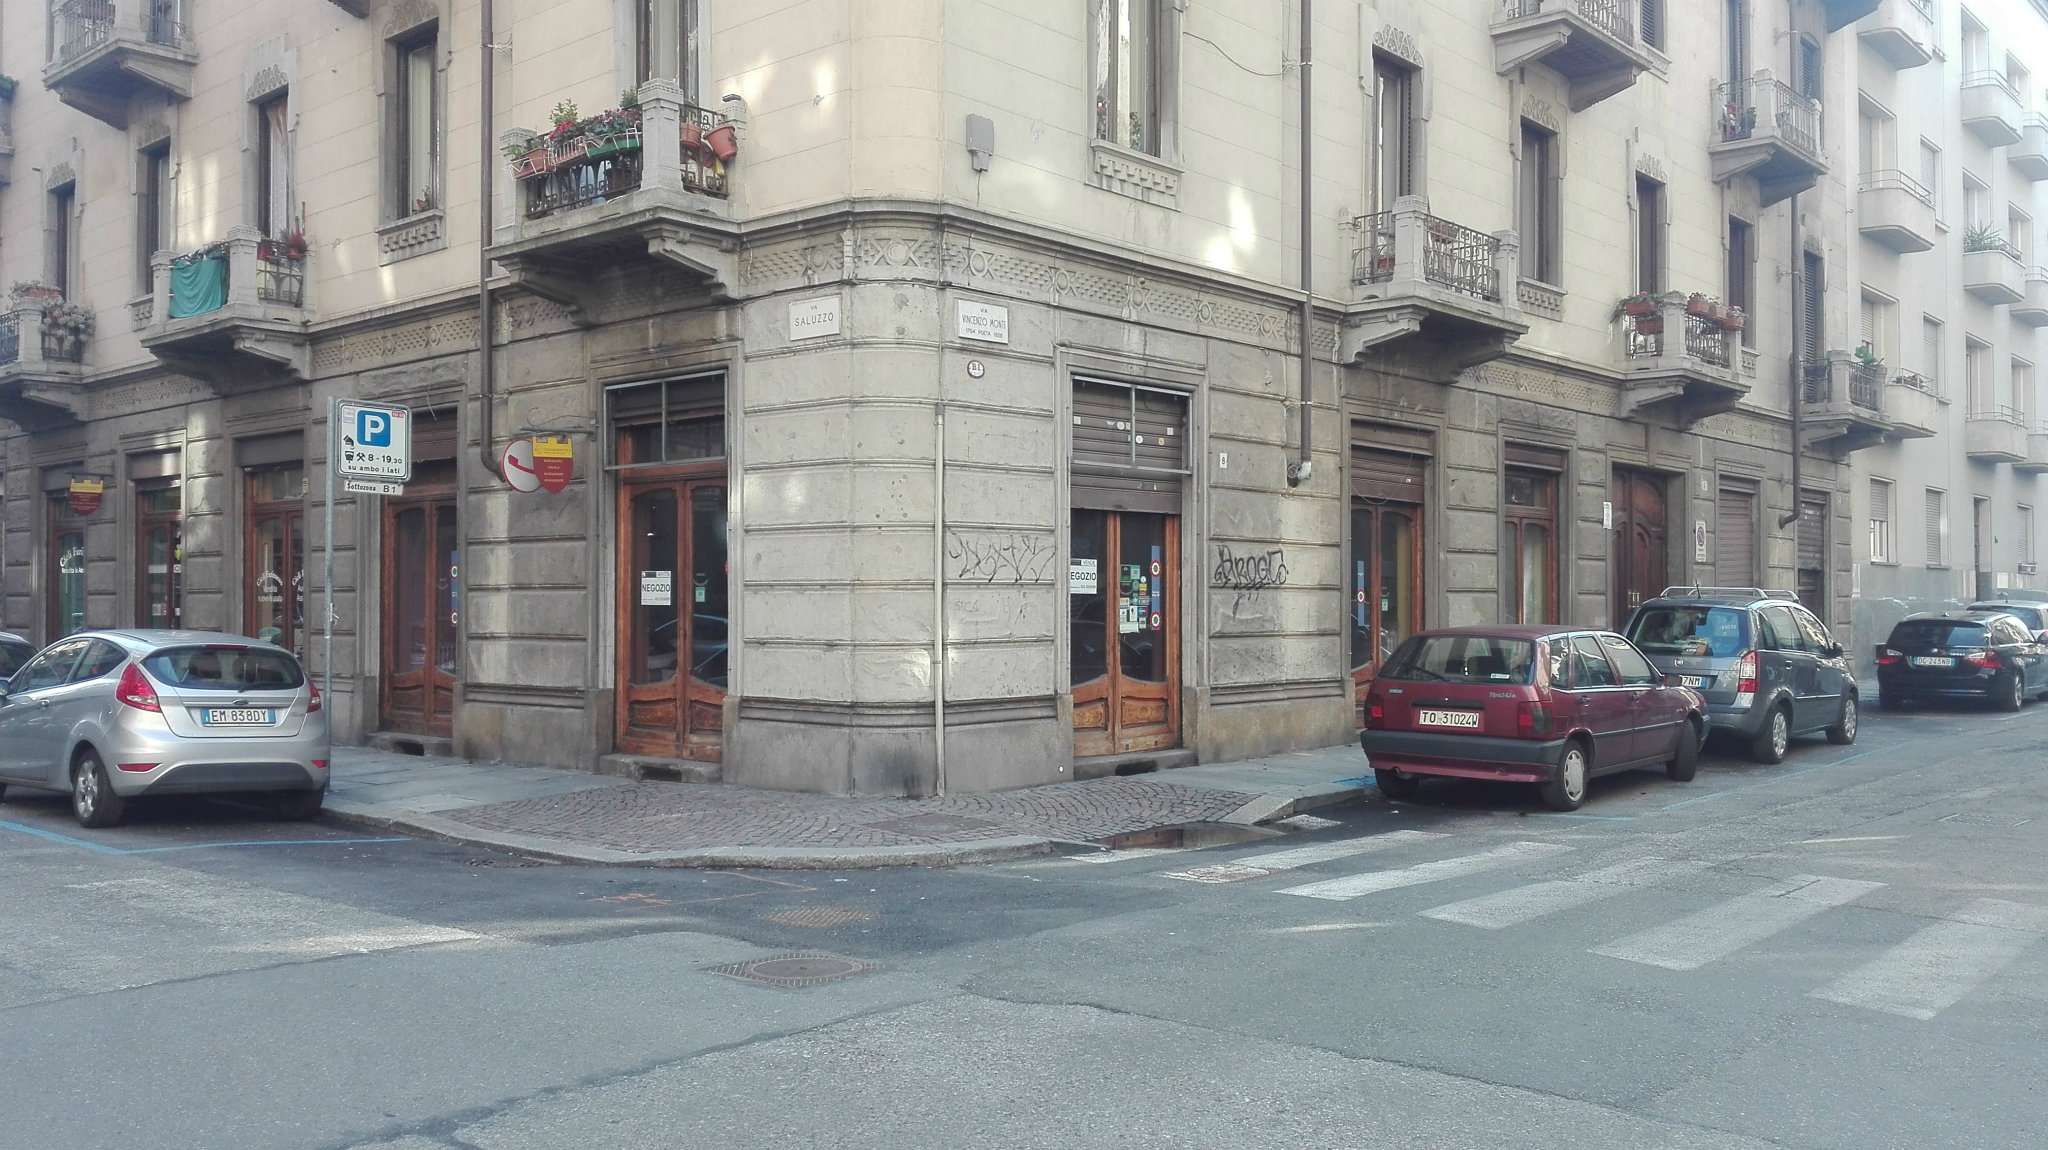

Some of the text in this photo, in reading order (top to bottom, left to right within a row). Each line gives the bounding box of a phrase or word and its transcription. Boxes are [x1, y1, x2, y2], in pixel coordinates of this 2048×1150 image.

[793, 312, 834, 327] SALUZZO
[962, 313, 988, 327] VINCENZO
[364, 414, 385, 442] P
[368, 453, 374, 462] 8
[360, 465, 380, 473] ambo
[387, 466, 400, 474] lati
[1070, 571, 1097, 581] EGOZIO
[642, 583, 671, 593] NEGOZIO
[1681, 675, 1702, 687] 7NM
[211, 710, 267, 722] EM 838DY
[1422, 711, 1436, 723] TO
